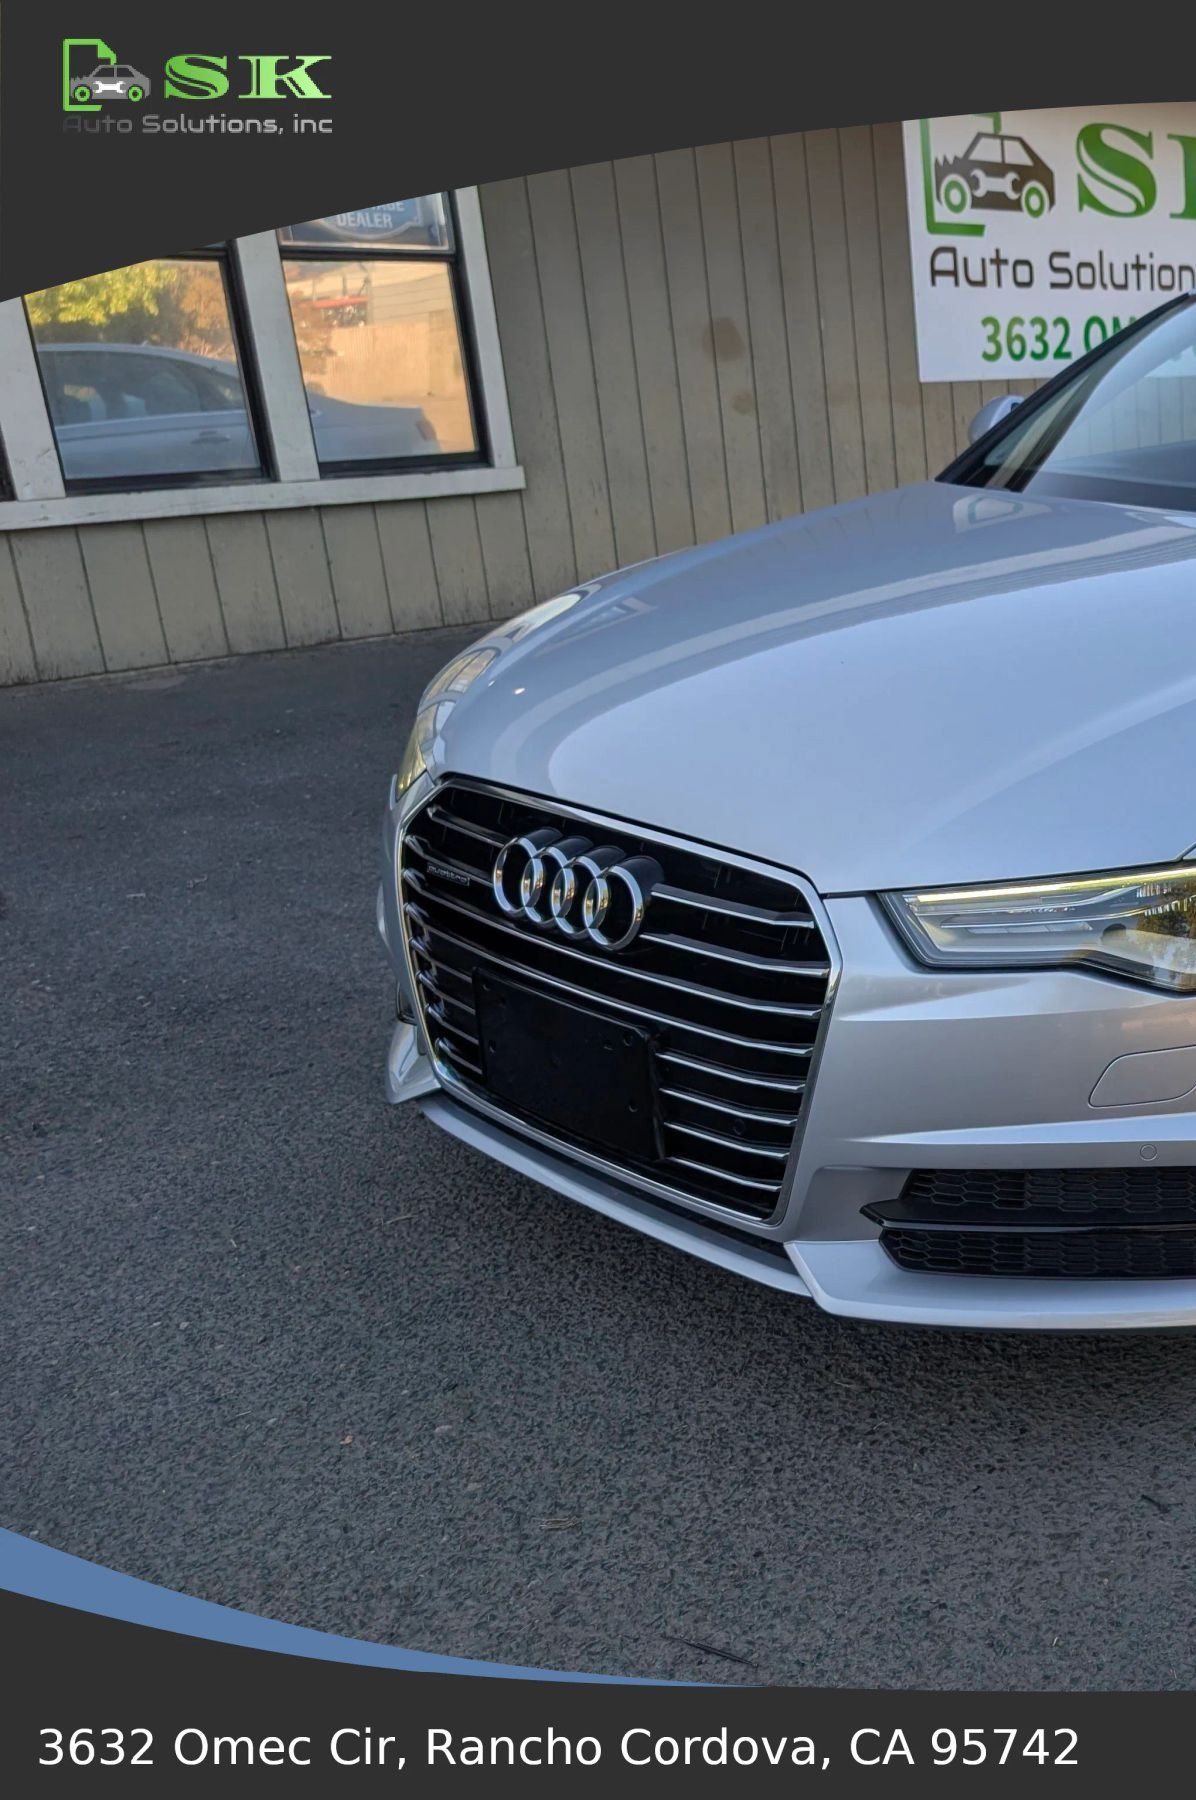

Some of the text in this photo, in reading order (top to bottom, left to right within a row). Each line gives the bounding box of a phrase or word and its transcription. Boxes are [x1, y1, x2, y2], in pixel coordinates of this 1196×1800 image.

[336, 211, 394, 229] DEALER
[929, 246, 1036, 289] Auto
[981, 315, 1073, 362] 3632
